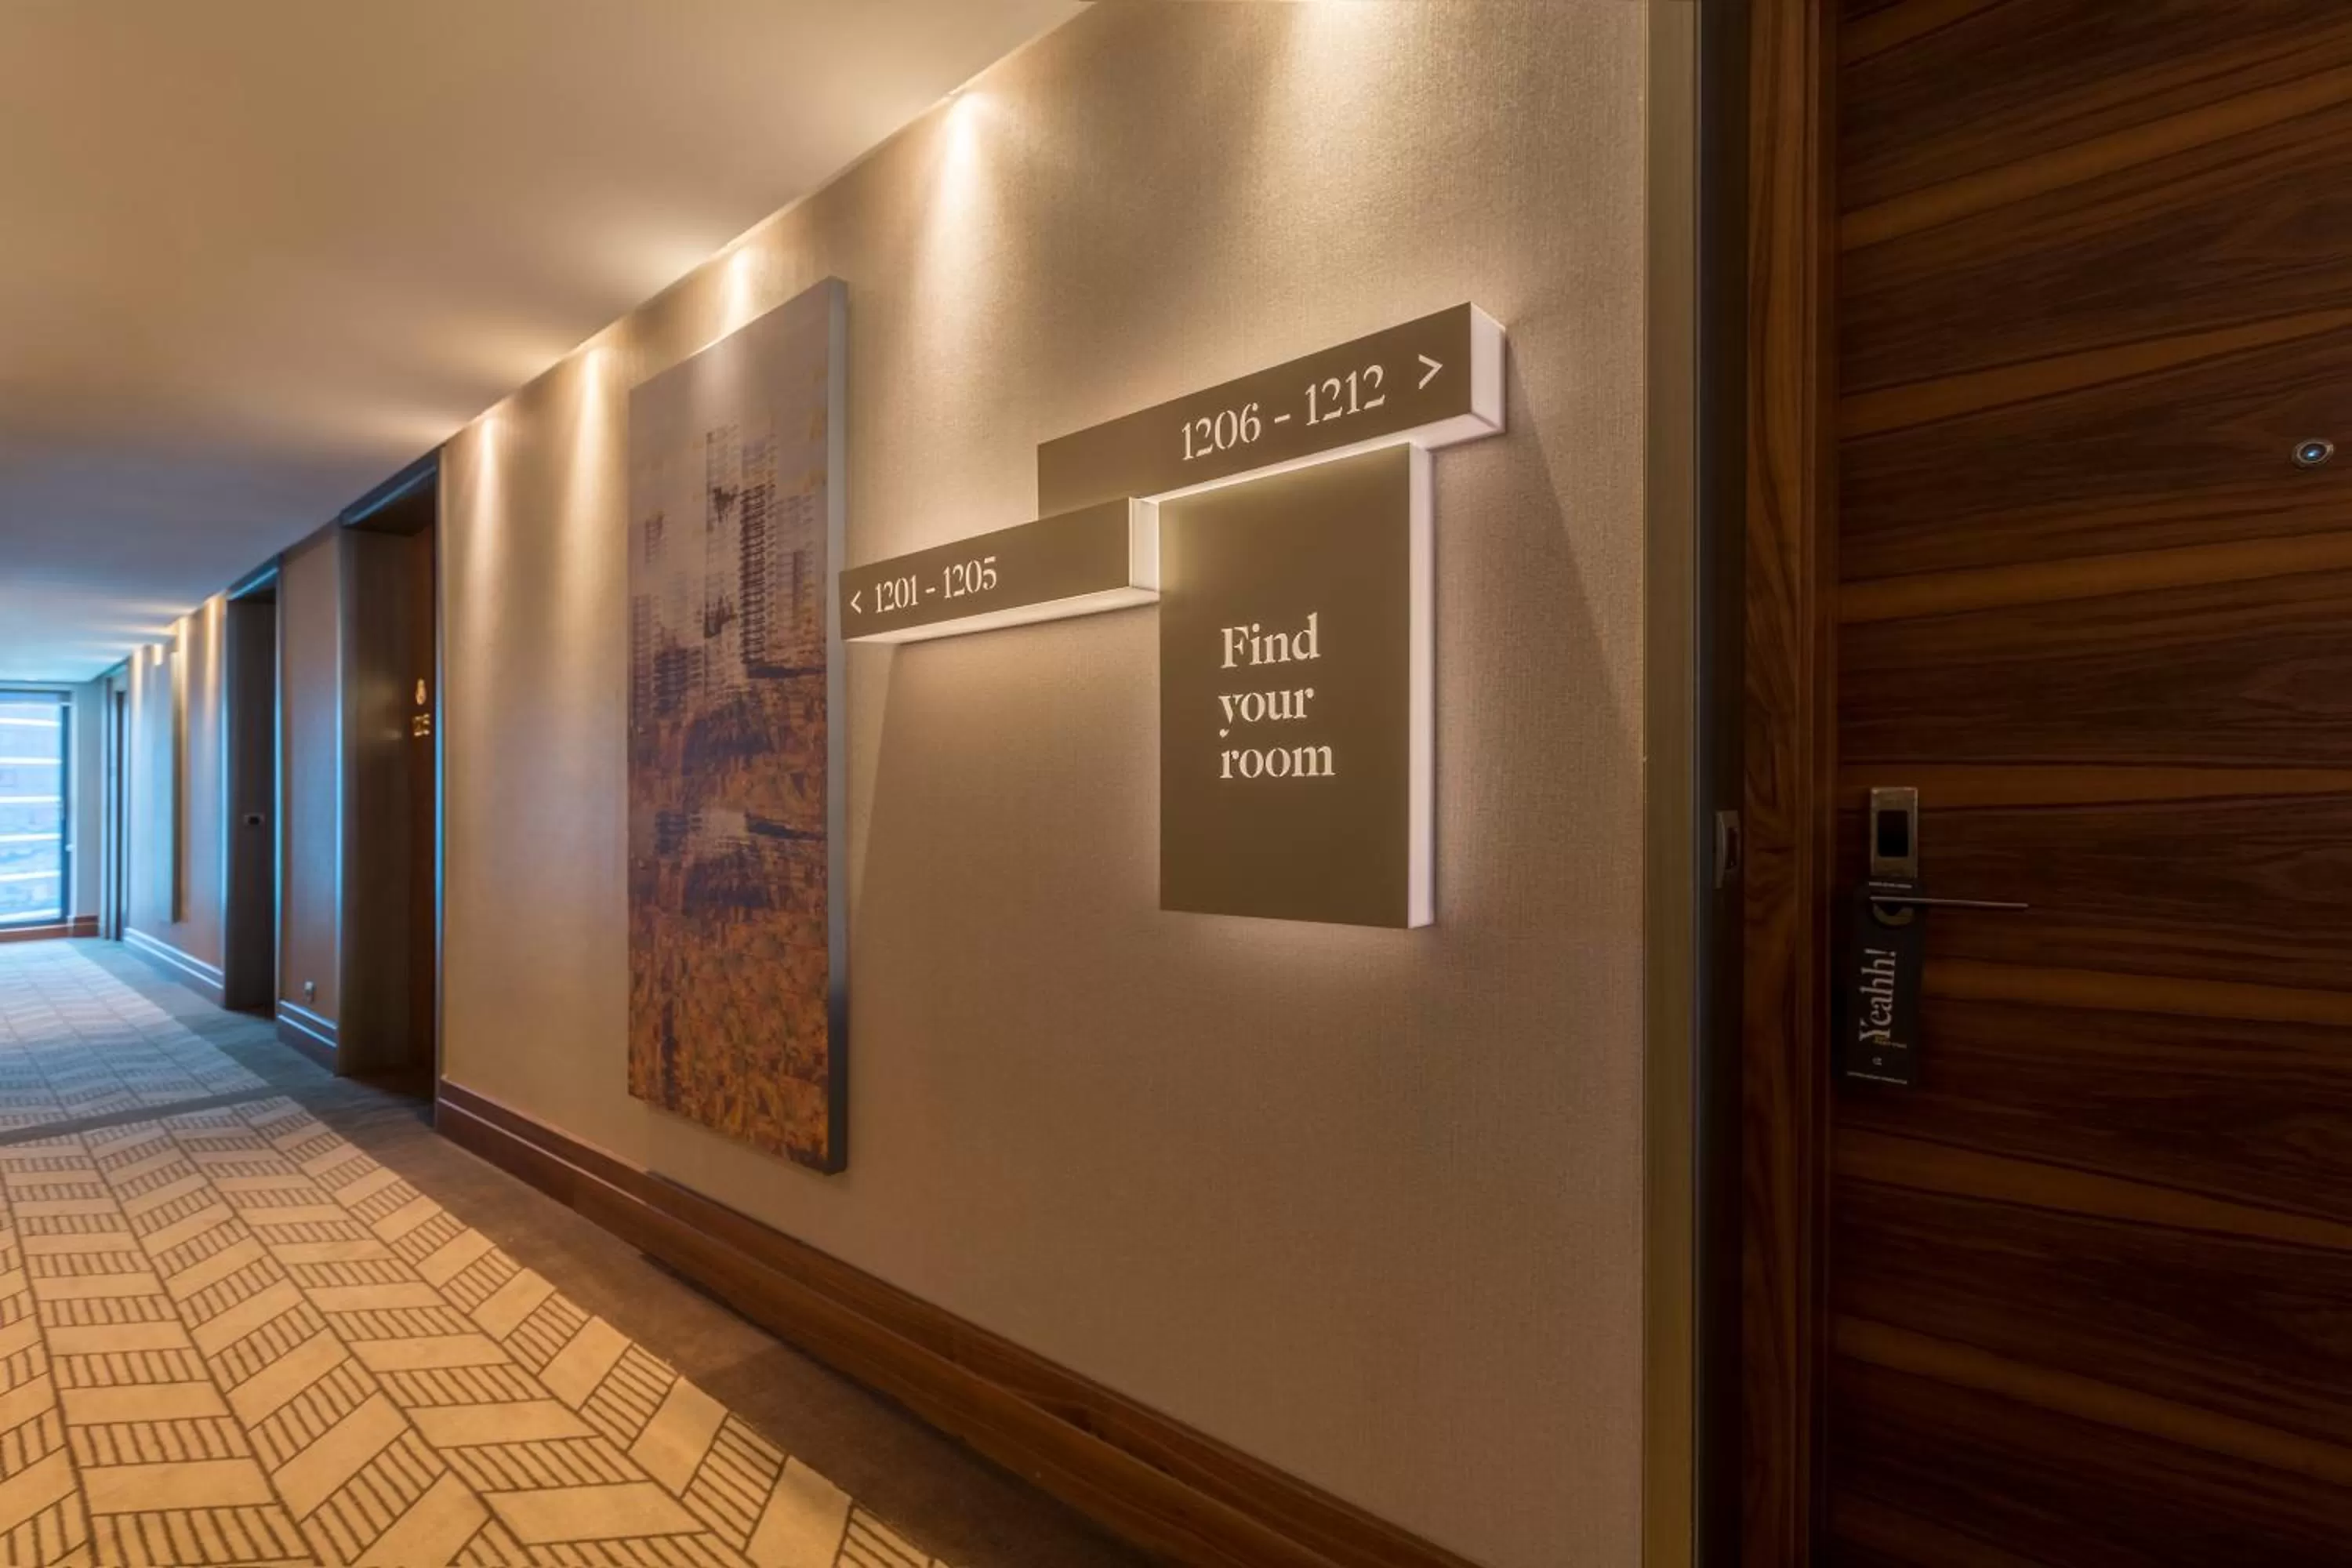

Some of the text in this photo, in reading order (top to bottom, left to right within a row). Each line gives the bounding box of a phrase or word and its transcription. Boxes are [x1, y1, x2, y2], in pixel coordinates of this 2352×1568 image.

[1181, 402, 1261, 461] 1206
[1305, 365, 1385, 426] 1212
[874, 575, 919, 614] 1201
[943, 556, 997, 600] 1205
[1221, 612, 1321, 669] Find
[1218, 687, 1315, 738] your
[1219, 744, 1336, 779] room
[1858, 948, 1897, 1042] Yeahh!
